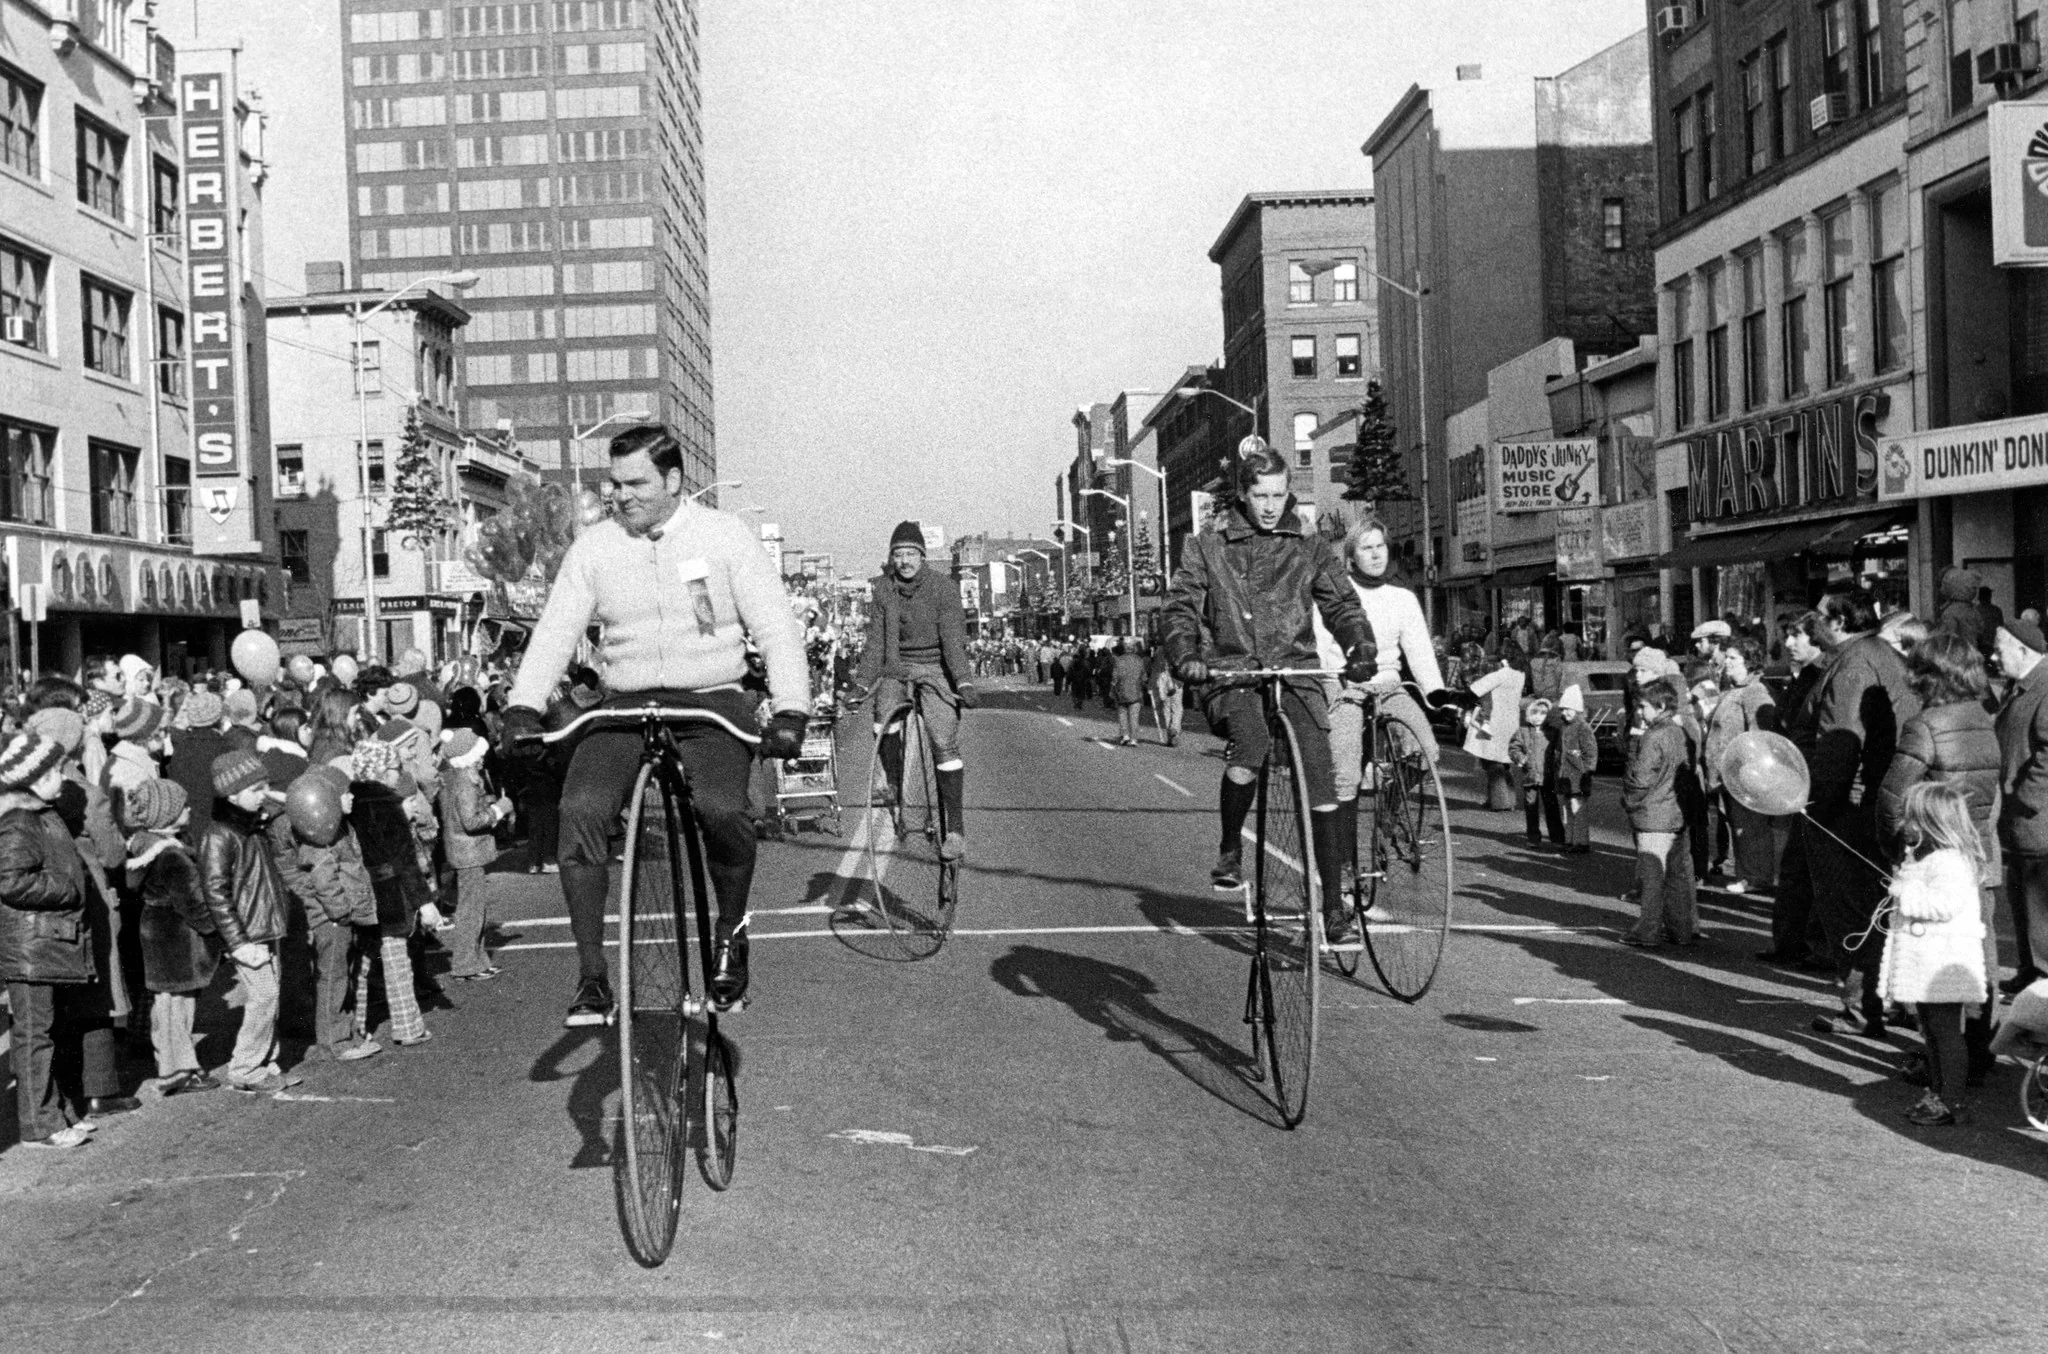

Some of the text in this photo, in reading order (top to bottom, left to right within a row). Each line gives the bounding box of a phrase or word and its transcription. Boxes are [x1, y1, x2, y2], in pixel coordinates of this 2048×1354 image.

[184, 78, 234, 465] HERBERT'S
[1552, 443, 1591, 467] JUNKY
[1923, 432, 2048, 480] DUNKIN' DON
[1502, 469, 1556, 483] MUSIC
[1503, 484, 1552, 498] STORE
